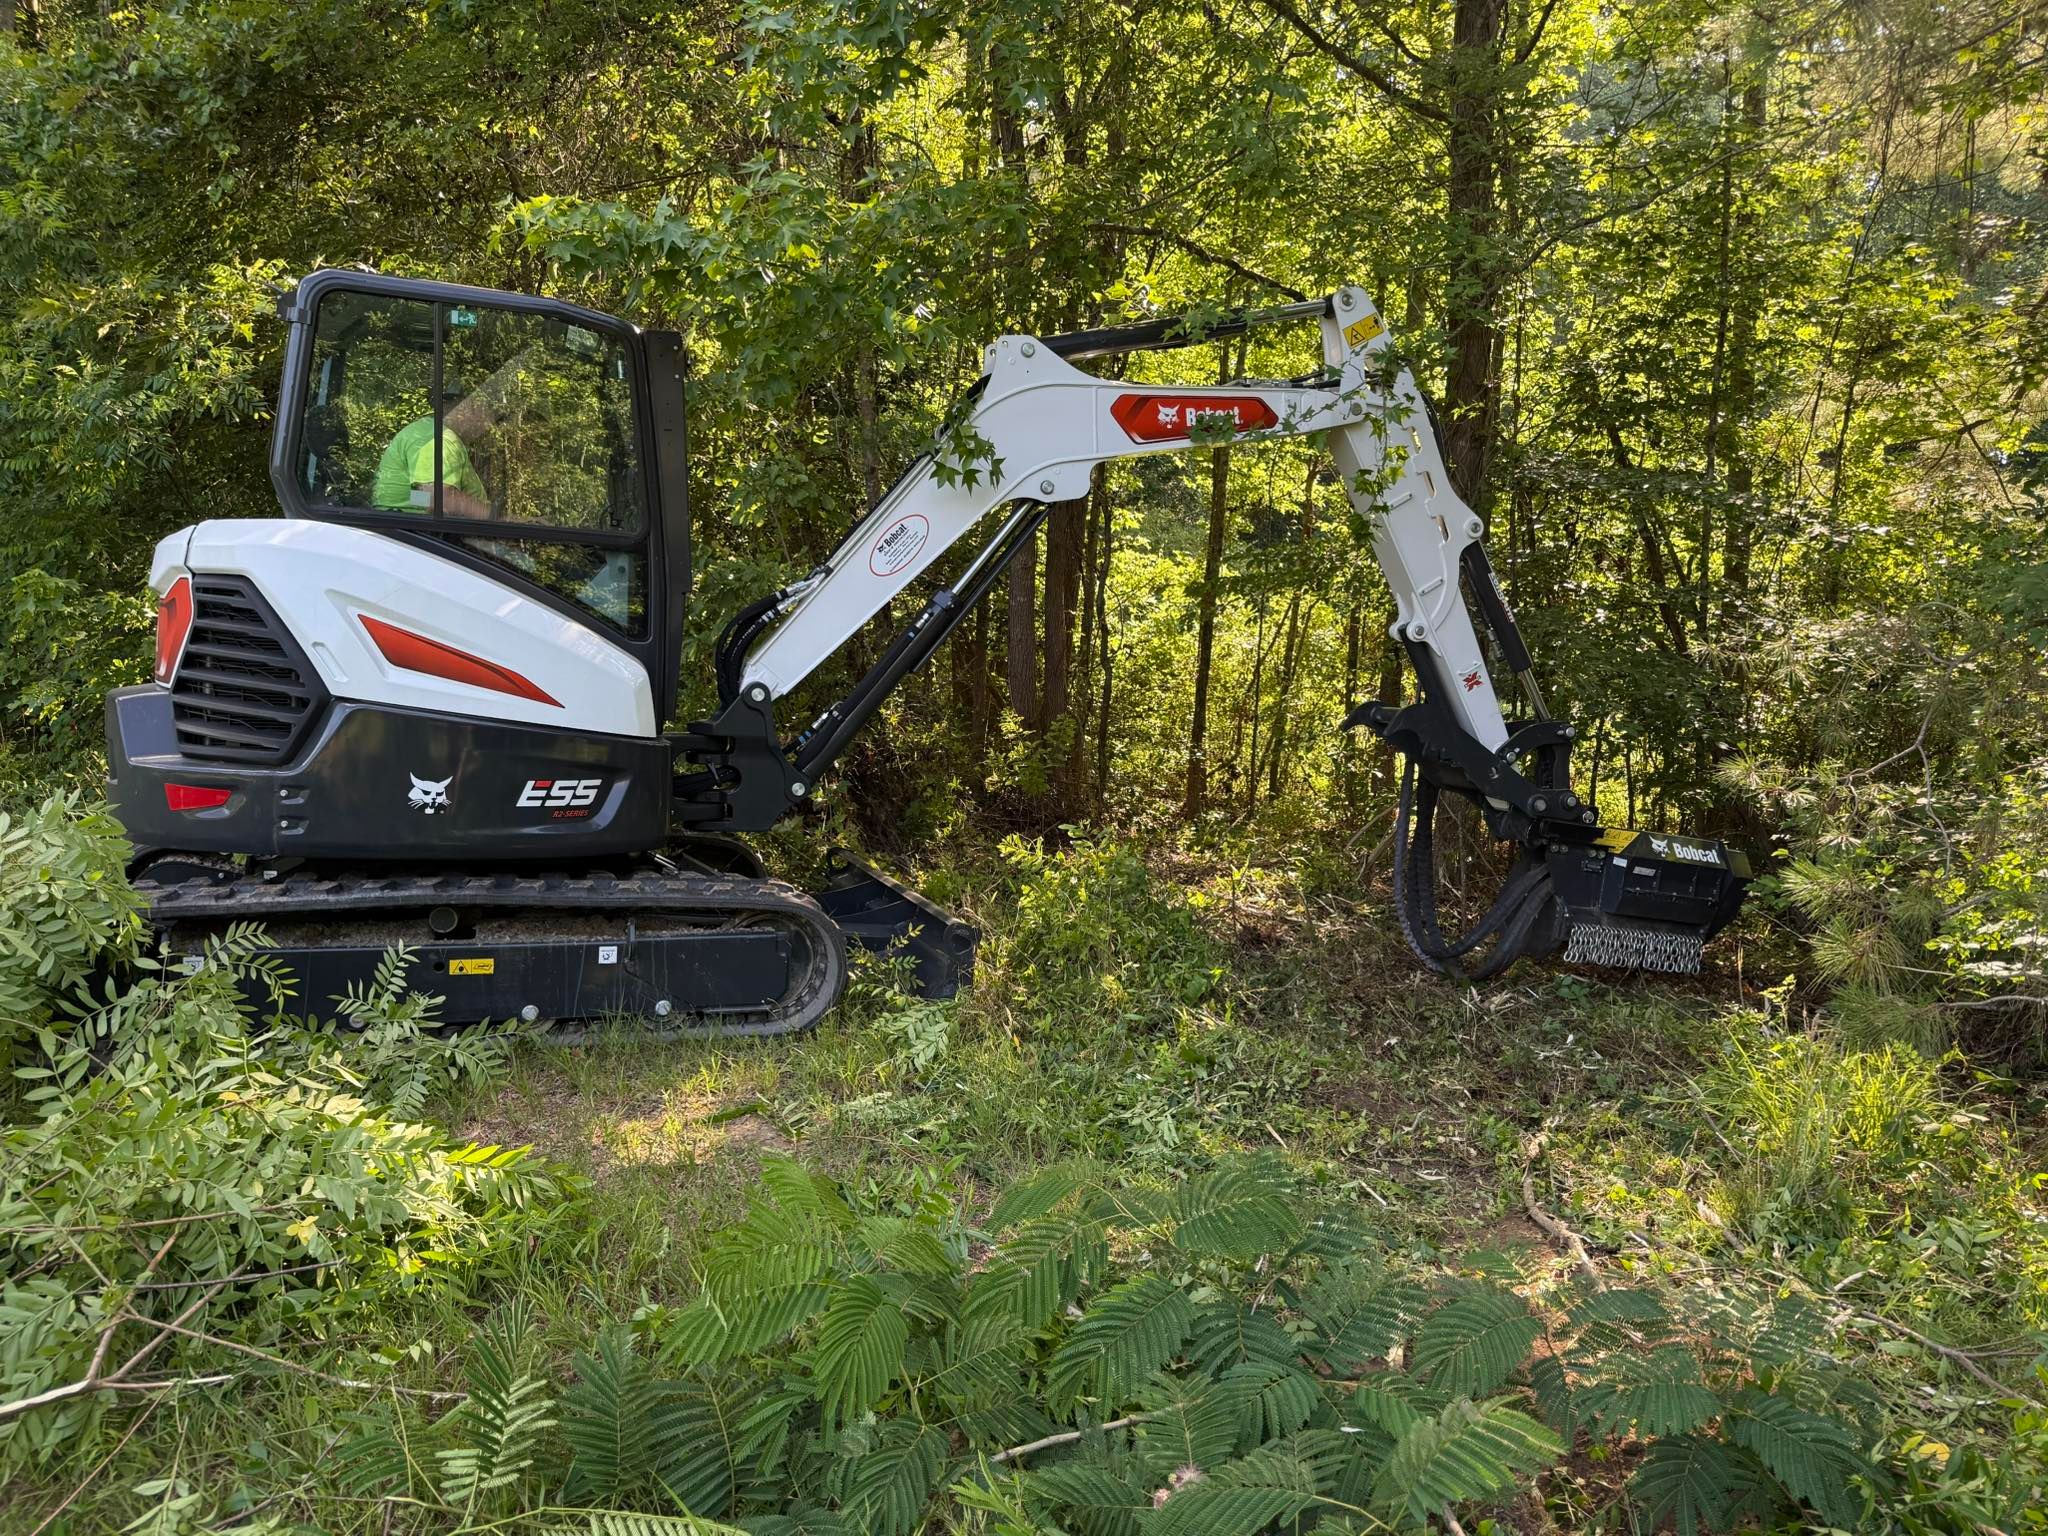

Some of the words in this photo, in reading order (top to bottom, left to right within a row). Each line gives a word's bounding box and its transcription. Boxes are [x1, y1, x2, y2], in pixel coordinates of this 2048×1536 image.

[884, 523, 907, 547] Bobcat
[552, 809, 589, 818] R2-SERIES
[1672, 843, 1720, 864] Bobcat
